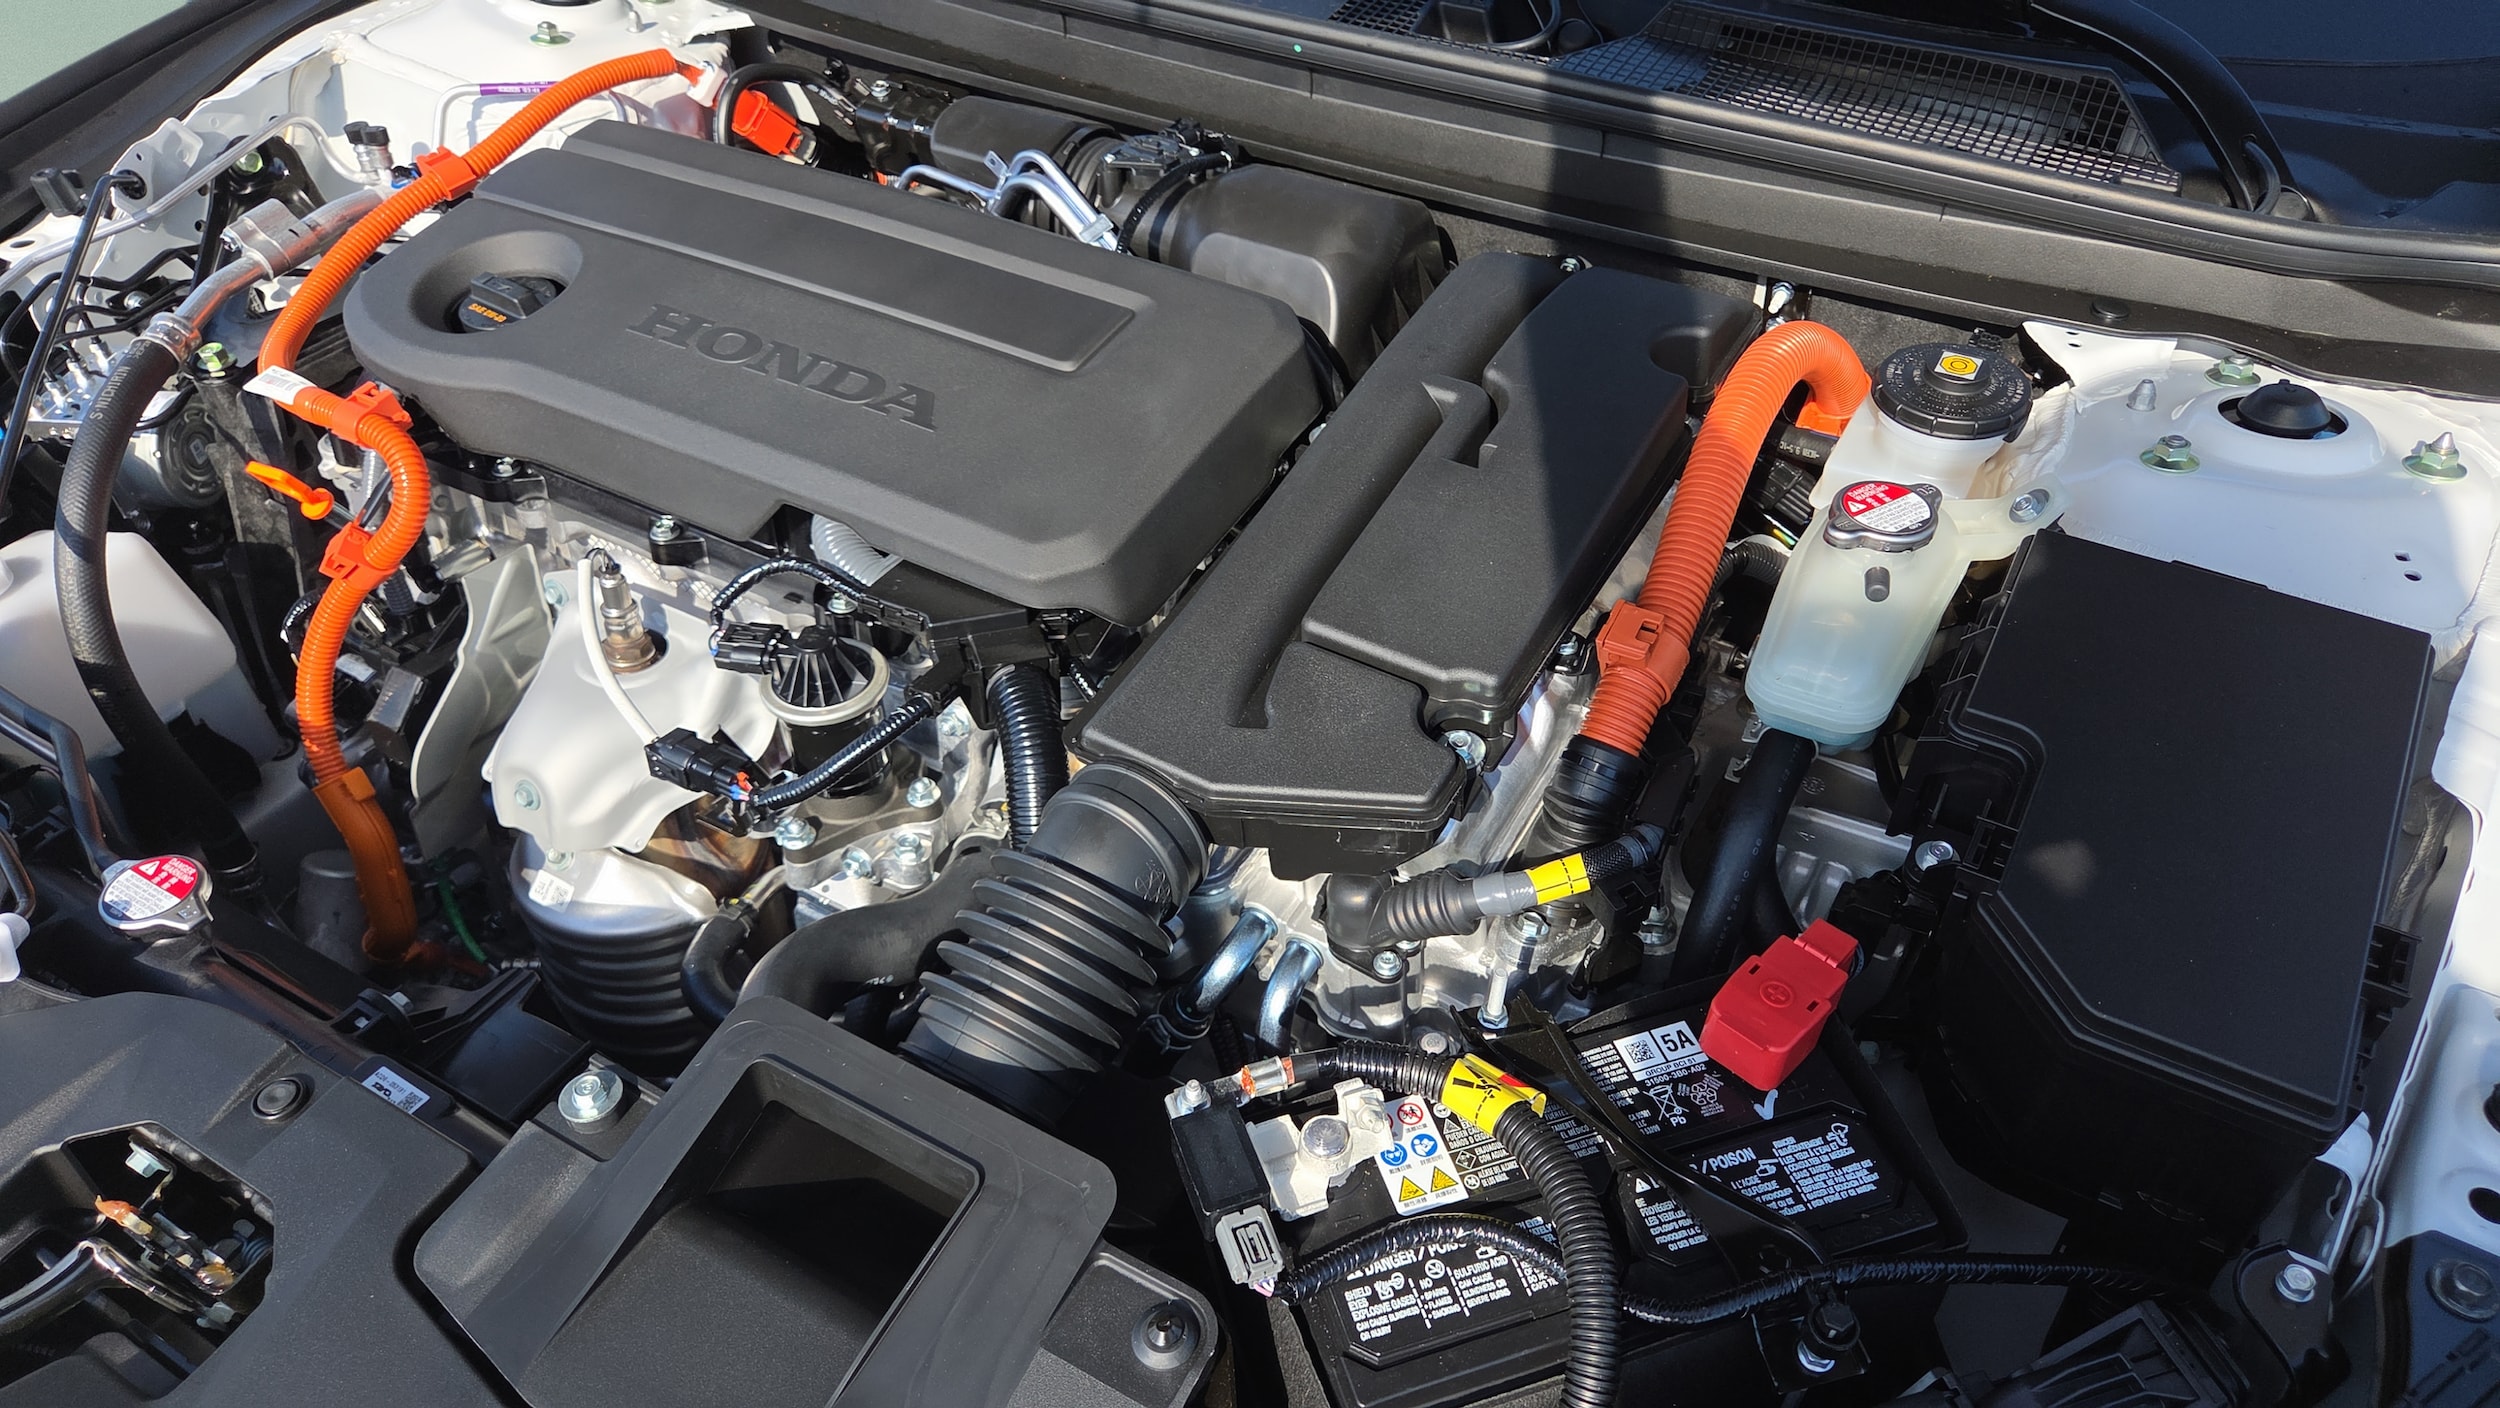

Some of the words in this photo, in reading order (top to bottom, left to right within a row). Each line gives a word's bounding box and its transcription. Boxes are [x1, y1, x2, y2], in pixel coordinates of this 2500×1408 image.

[626, 303, 938, 433] HONDA
[1846, 483, 1877, 498] DANGER
[1855, 485, 1889, 502] WARNING
[1660, 1029, 1695, 1053] 5A
[1645, 1064, 1673, 1077] GROUP
[1673, 1059, 1687, 1069] BCI
[1636, 1119, 1646, 1128] LLC
[1669, 1115, 1687, 1128] Pb
[1445, 1129, 1467, 1141] PUEDEN
[1448, 1136, 1468, 1149] DAÑOS
[1478, 1153, 1491, 1163] CON
[1708, 1147, 1757, 1171] POISON
[1363, 1250, 1416, 1275] DANGER
[1453, 1261, 1490, 1279] SULFURIC
[1489, 1254, 1508, 1268] ACID
[1419, 1278, 1432, 1289] NO
[1458, 1279, 1471, 1289] CAN
[1472, 1272, 1492, 1285] CAUSE
[1462, 1282, 1496, 1299] BLINDNESS
[1495, 1278, 1506, 1288] OR
[1344, 1285, 1371, 1301] SHIELD
[1348, 1297, 1368, 1311] EYES
[1351, 1301, 1391, 1321] EXPLOSIVE
[1390, 1294, 1416, 1309] GASES
[1427, 1295, 1452, 1309] FLAMES
[1355, 1320, 1369, 1331] CAN
[1369, 1315, 1388, 1327] CAUSE
[1359, 1331, 1370, 1341] OR
